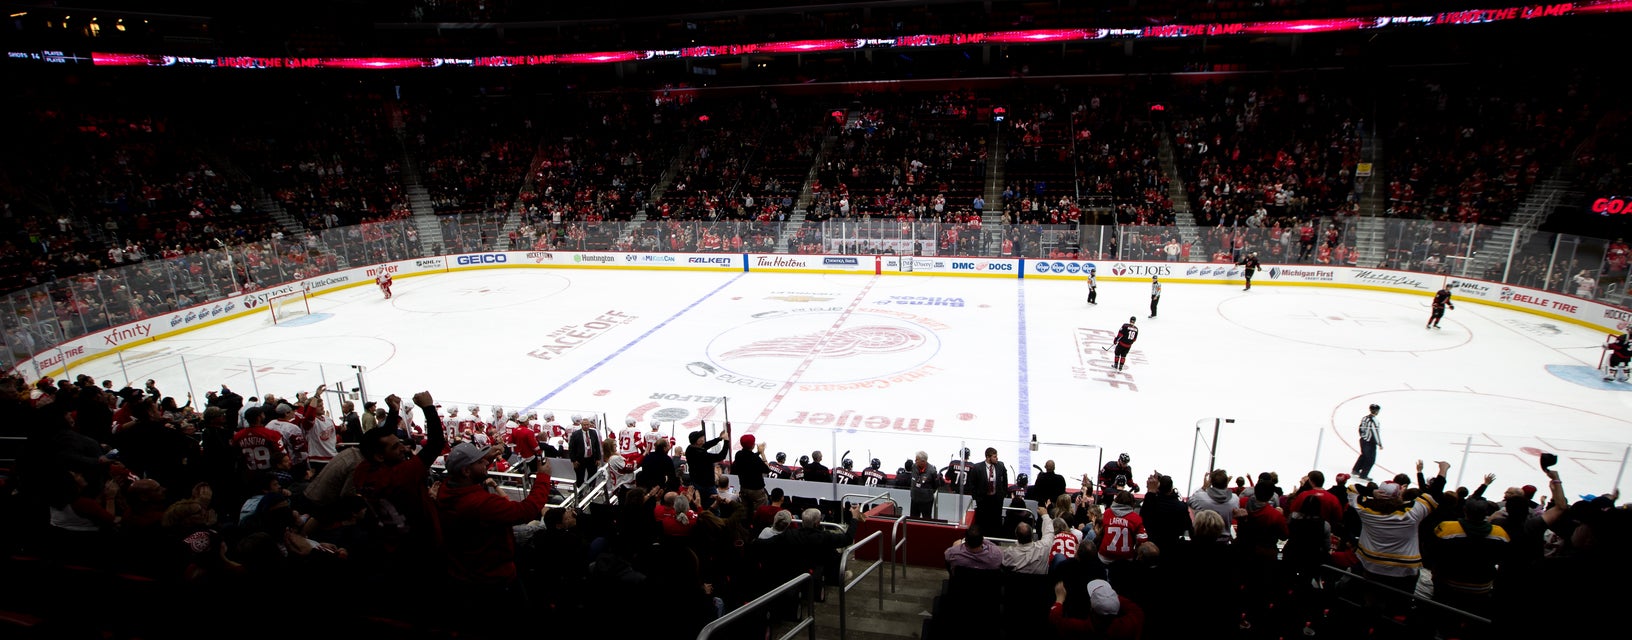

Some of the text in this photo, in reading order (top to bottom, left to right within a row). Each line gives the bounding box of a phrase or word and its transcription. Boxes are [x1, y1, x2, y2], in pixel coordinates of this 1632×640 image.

[1487, 8, 1518, 21] THE
[1521, 3, 1573, 19] LAMP
[1181, 24, 1205, 36] THE
[1207, 23, 1242, 35] LAMP
[930, 34, 951, 45] THE
[952, 33, 984, 44] LAMP
[255, 58, 282, 67] THE
[285, 58, 321, 67] LAMP
[457, 254, 507, 265] GEICO
[581, 254, 615, 264] Huntington
[756, 255, 806, 268] Tim Hortons
[952, 262, 975, 270] DMC
[988, 263, 1013, 271] DOCS
[1127, 264, 1171, 276] ST. JOE'S
[1281, 269, 1334, 278] Michigan First
[311, 276, 349, 289] Little Caesars
[1512, 293, 1578, 314] BELLE TIRE
[103, 323, 152, 346] xfinity
[526, 309, 629, 361] FACE-OFF
[39, 354, 64, 371] BELLE
[64, 345, 84, 359] TIRE
[717, 372, 778, 391] arena
[798, 378, 891, 393] Caesars
[786, 409, 936, 433] meijer
[239, 436, 266, 446] MANTHA
[242, 446, 271, 471] 39
[1109, 516, 1129, 526] LARKIN
[1107, 526, 1131, 552] 71
[1052, 538, 1077, 558] 39
